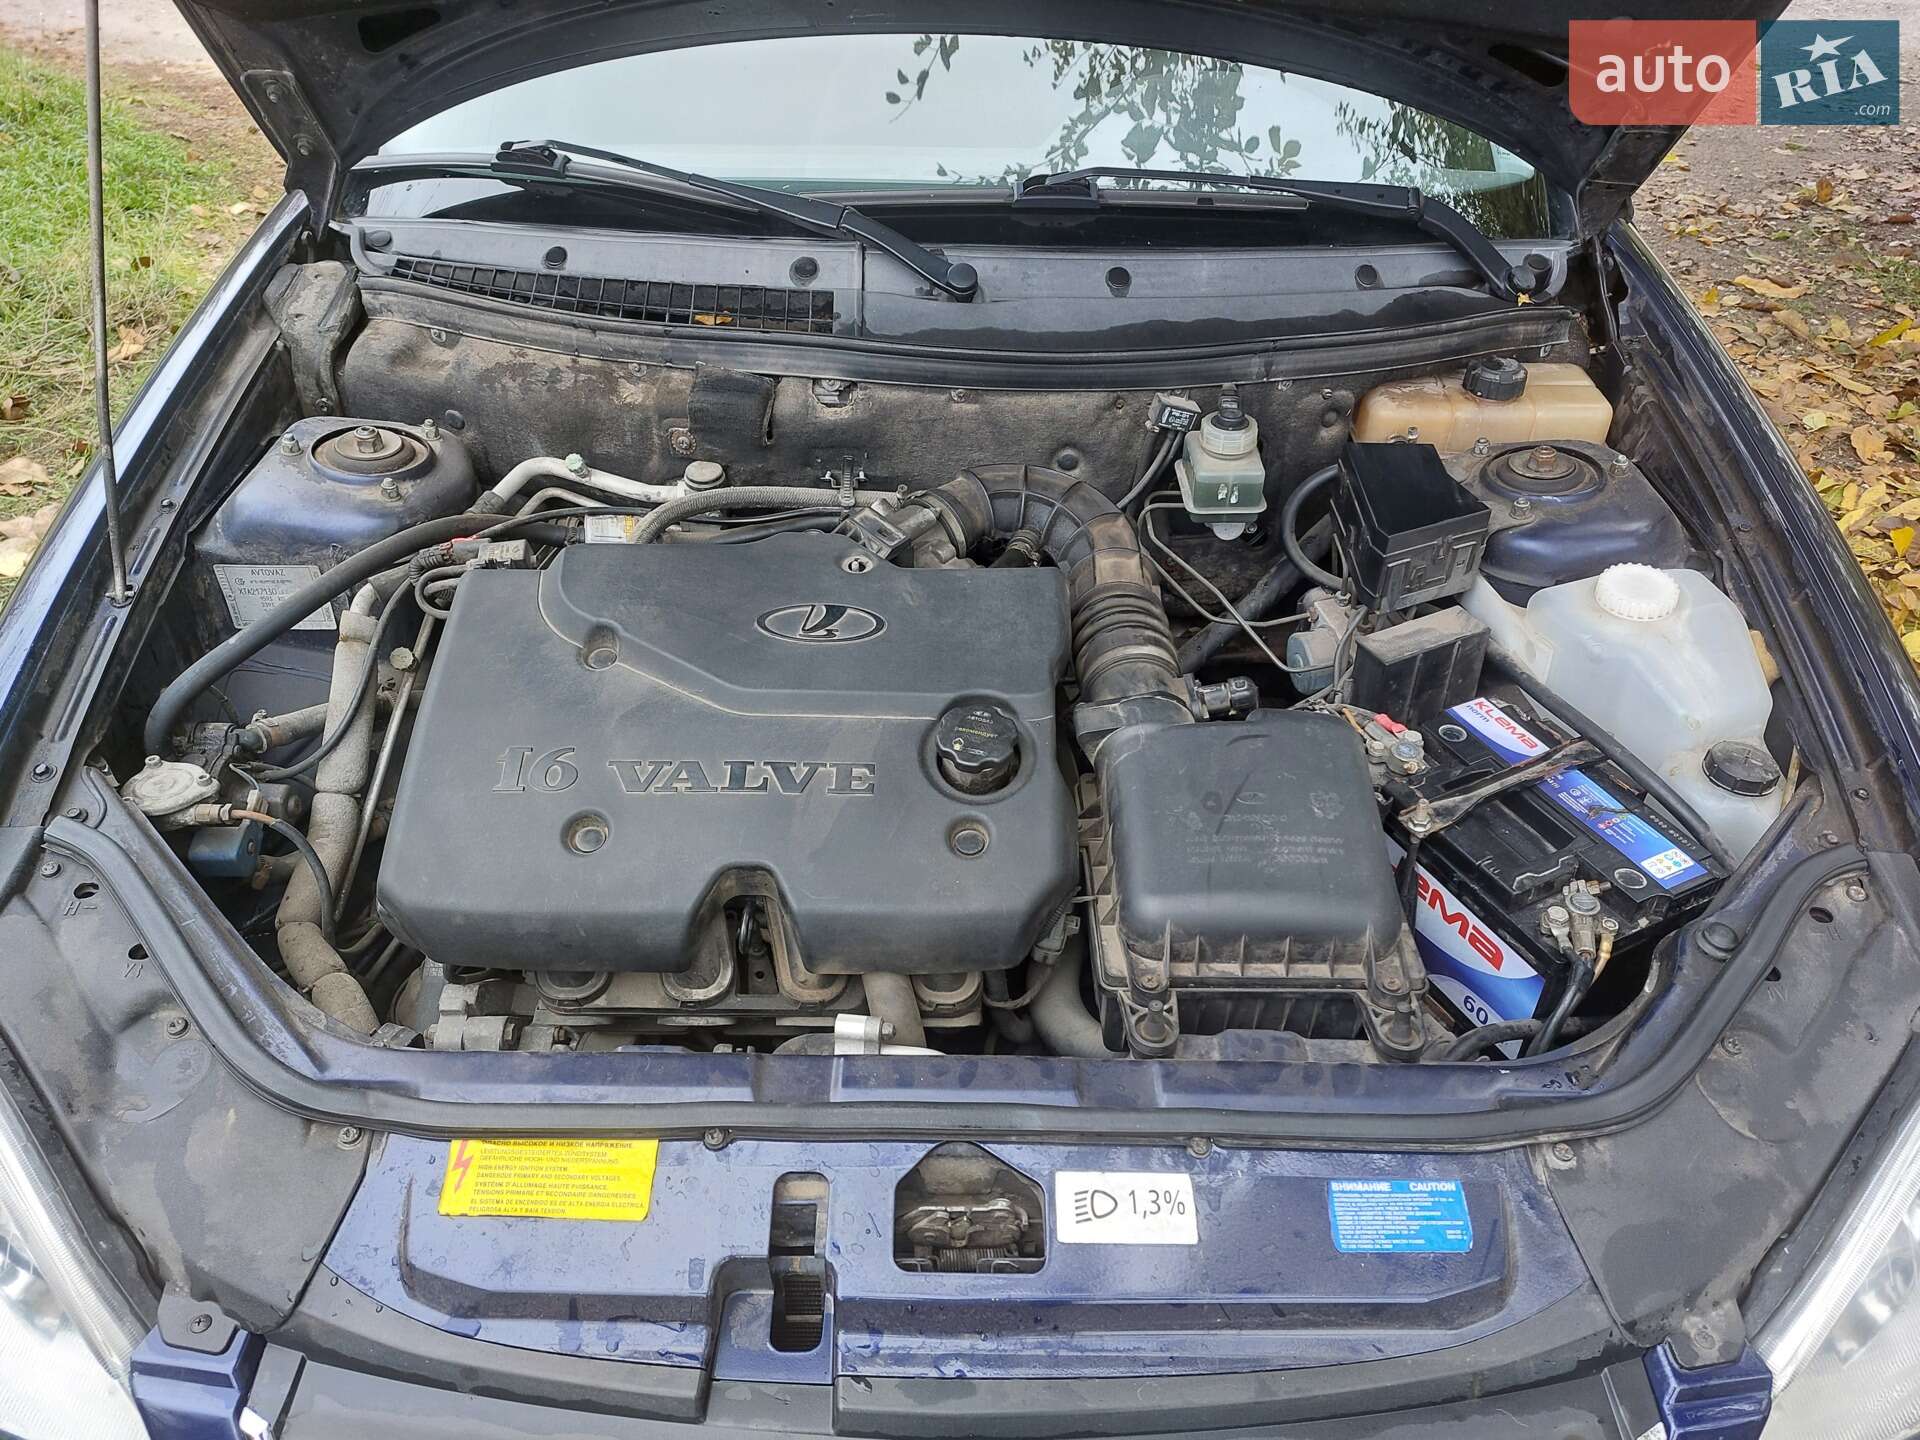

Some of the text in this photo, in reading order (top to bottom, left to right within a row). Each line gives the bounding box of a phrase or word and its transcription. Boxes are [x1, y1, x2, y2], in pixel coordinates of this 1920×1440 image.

[250, 568, 286, 577] AVTOVAZ
[1466, 704, 1490, 722] norm
[492, 746, 877, 796] 16 VALVE
[1416, 873, 1504, 972] eMa
[1463, 995, 1489, 1025] 60
[1331, 1182, 1392, 1192] ВНИМАНИЕ
[1409, 1182, 1457, 1192] CAUTION
[1128, 1189, 1185, 1219] 1,3%
